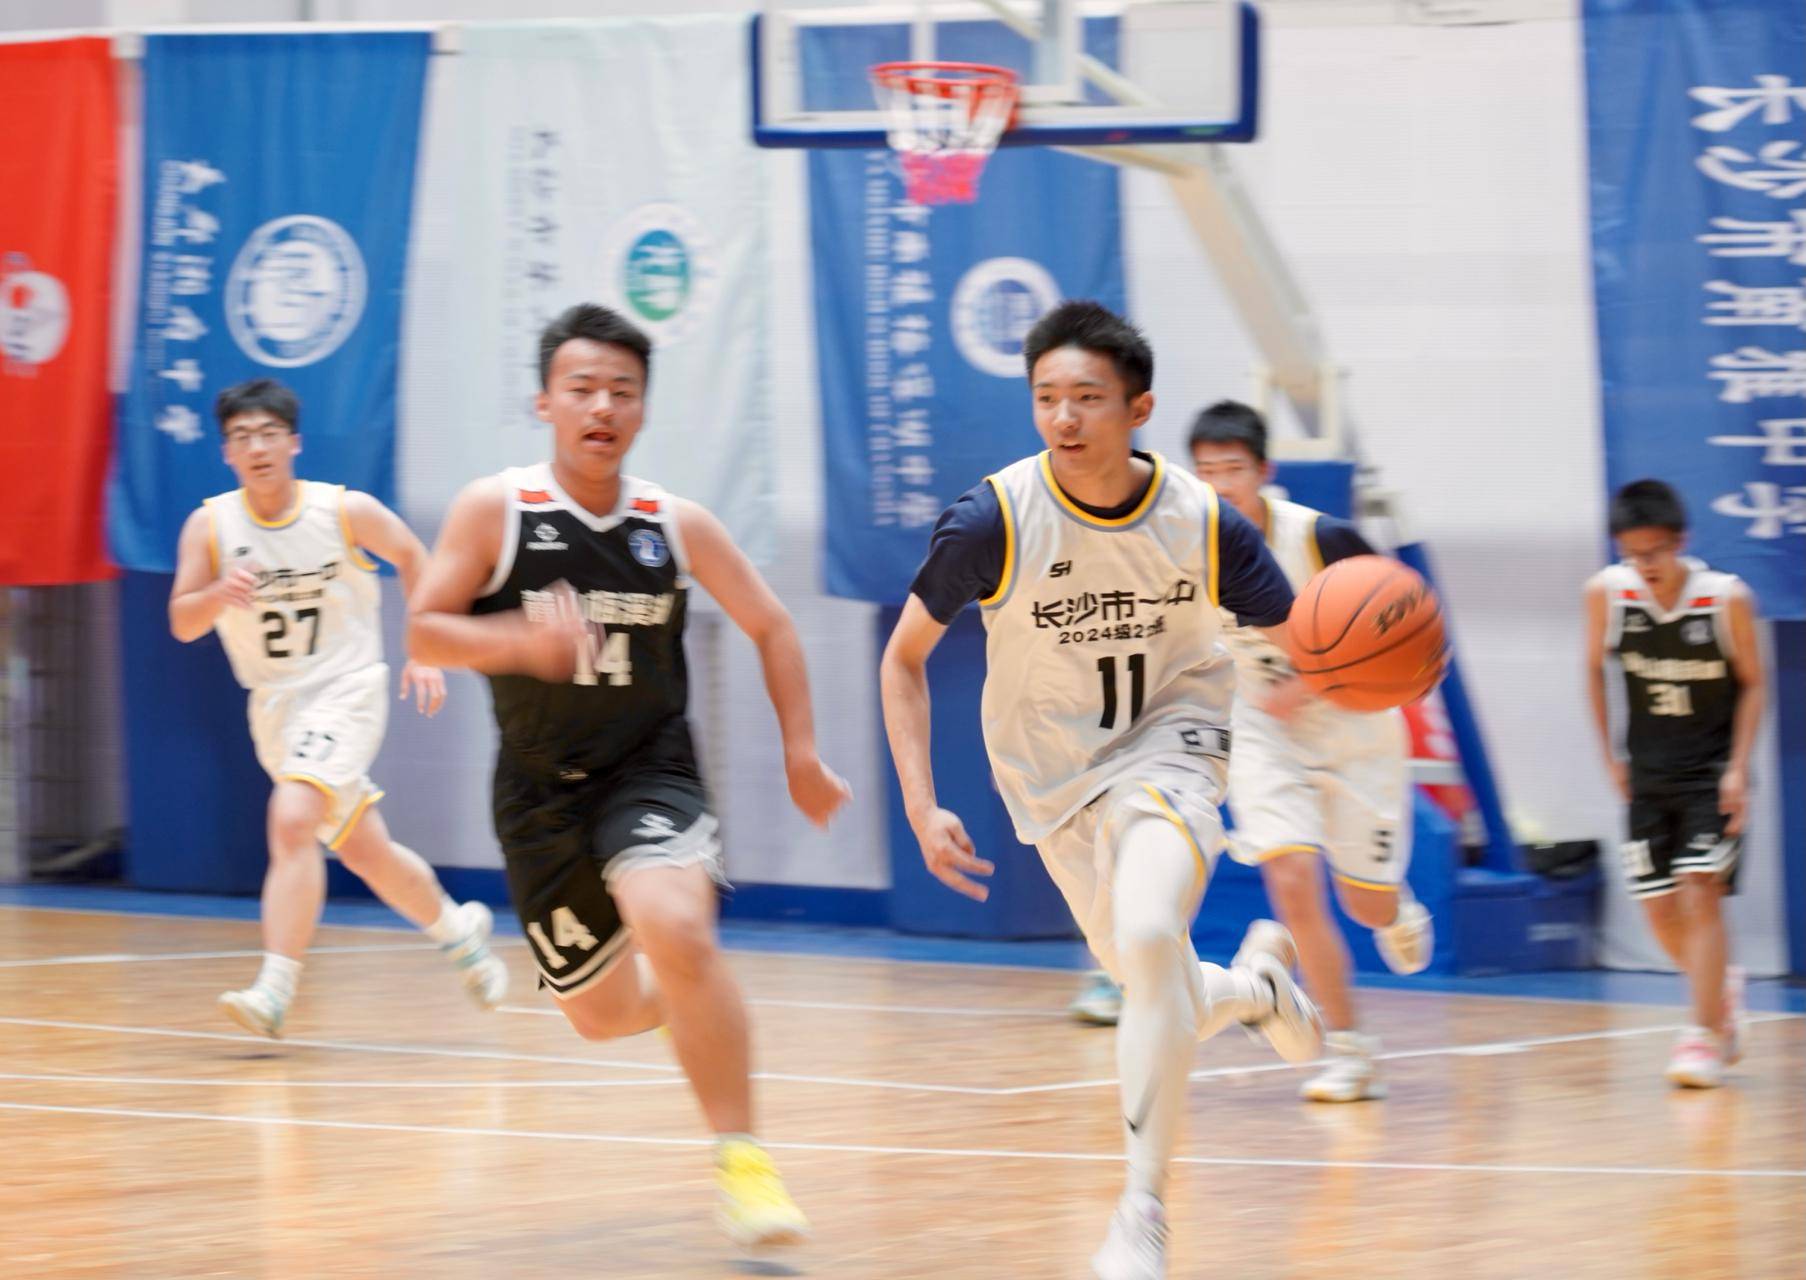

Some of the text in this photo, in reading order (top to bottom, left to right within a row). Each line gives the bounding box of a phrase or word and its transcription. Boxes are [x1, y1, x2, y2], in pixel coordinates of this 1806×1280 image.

[1031, 578, 1197, 629] 长沙市一中
[261, 607, 321, 659] 27
[573, 631, 633, 687] 14
[1097, 653, 1145, 730] 11
[1647, 683, 1694, 717] 31
[527, 905, 600, 970] 14
